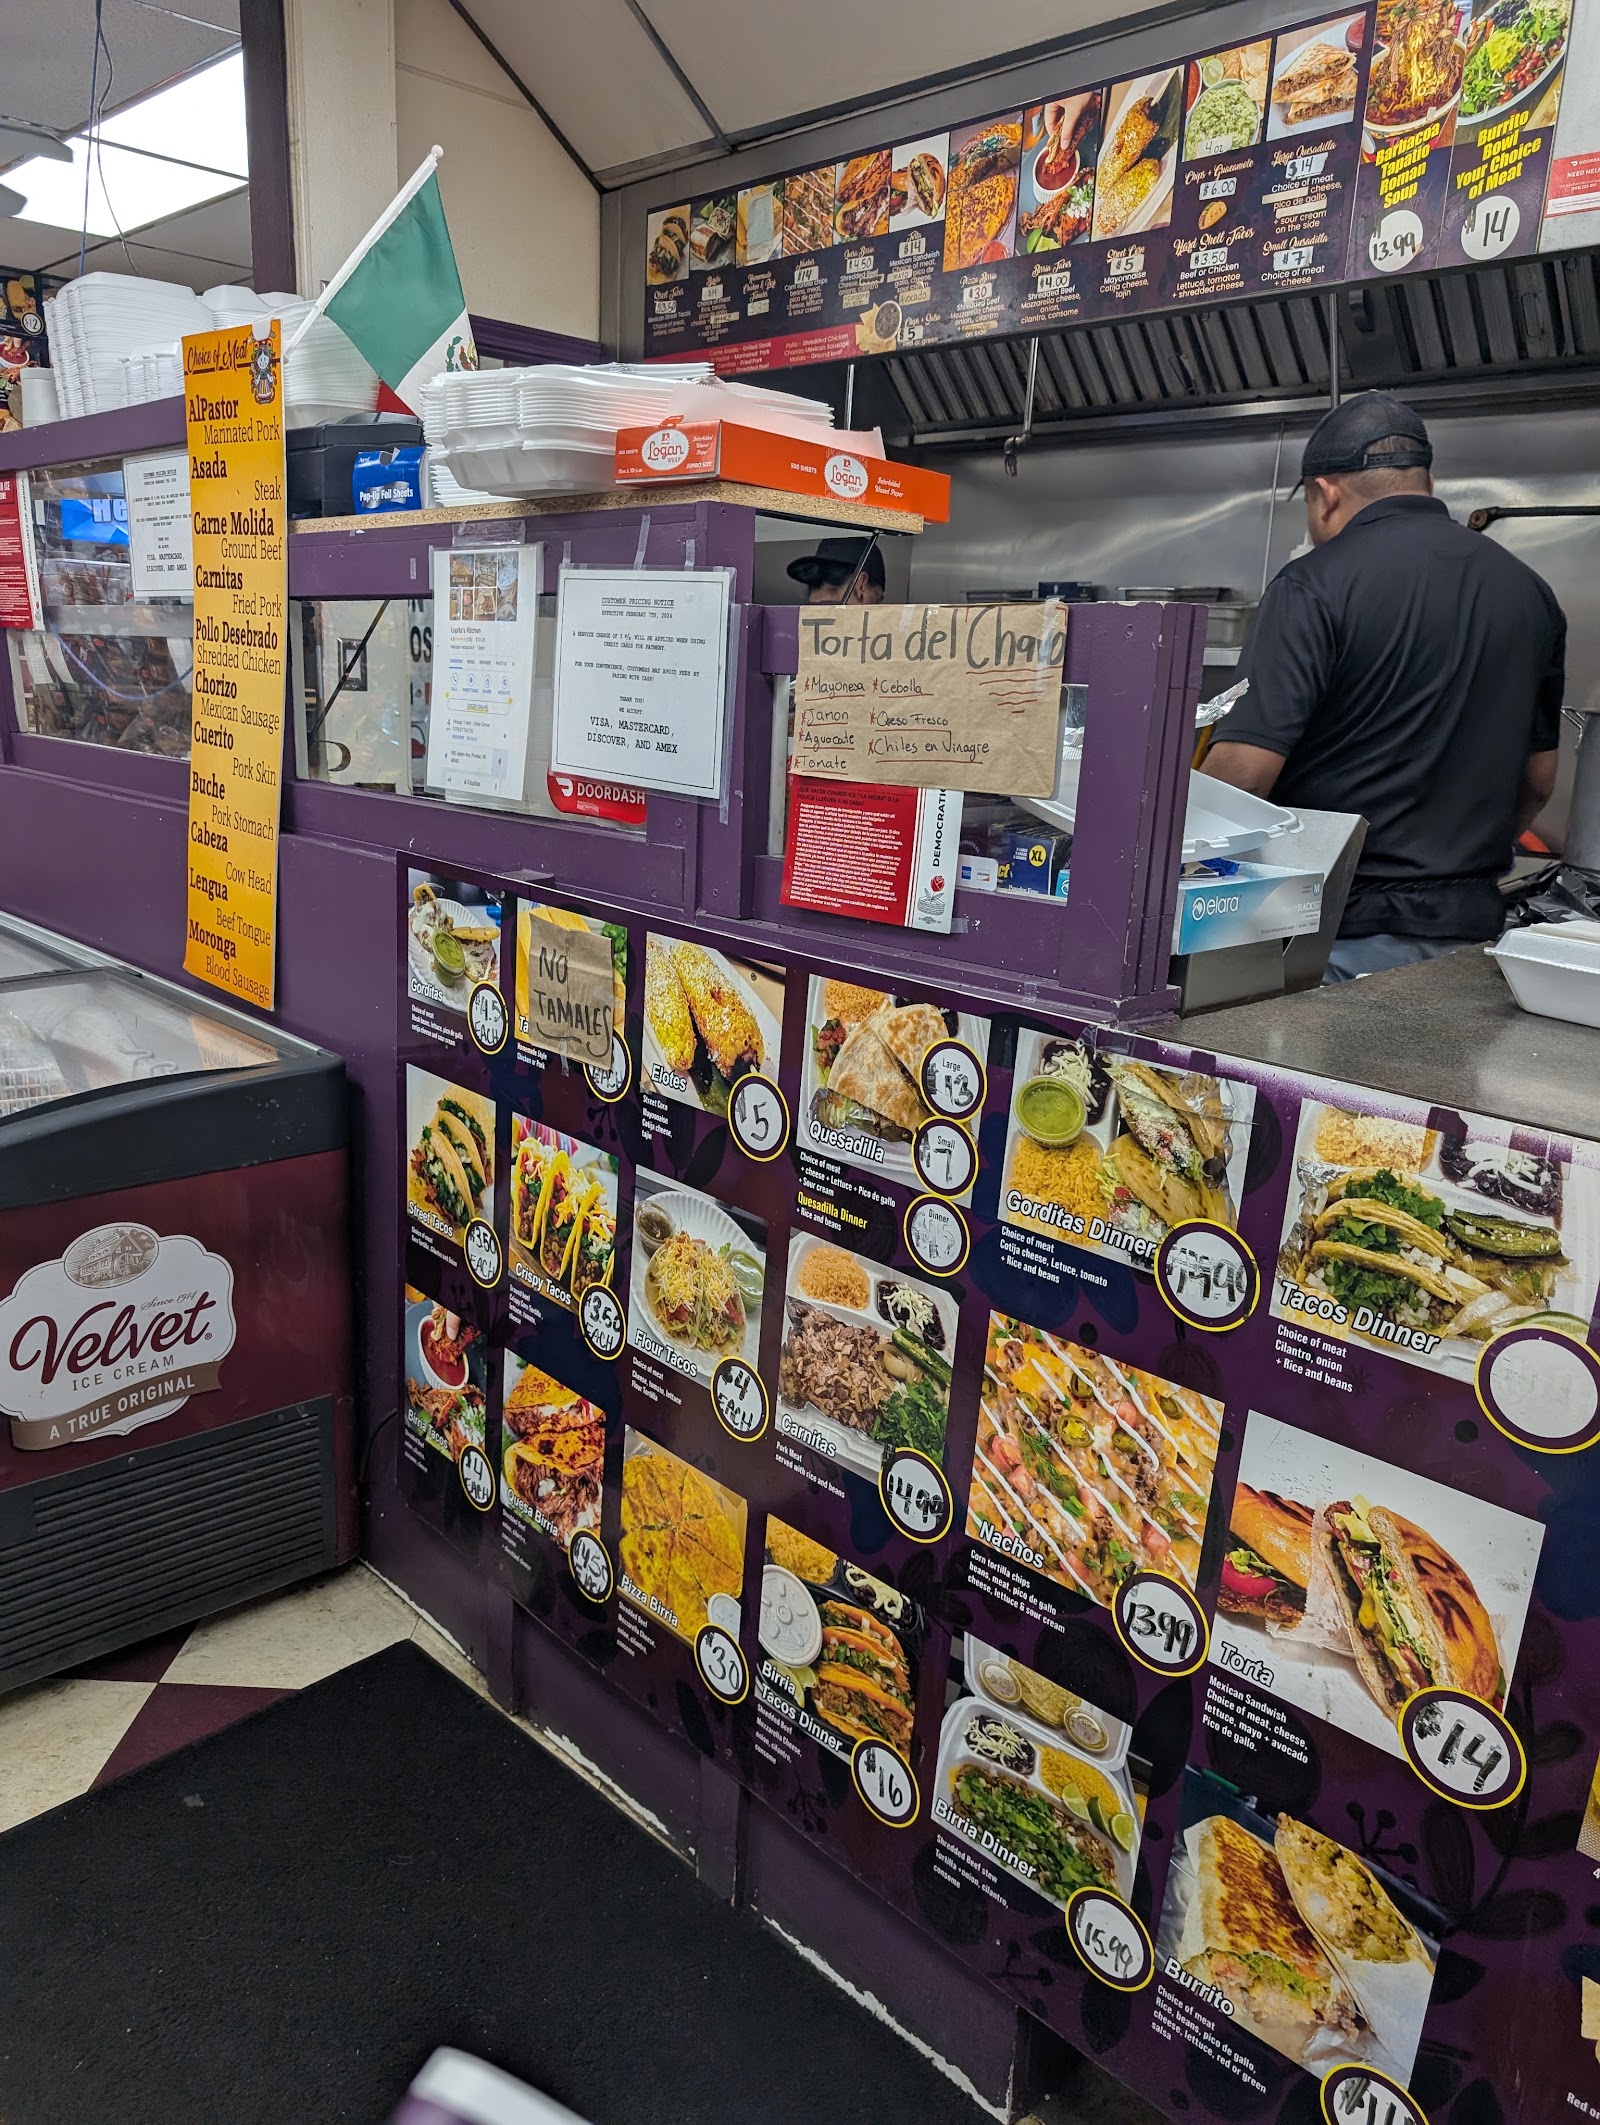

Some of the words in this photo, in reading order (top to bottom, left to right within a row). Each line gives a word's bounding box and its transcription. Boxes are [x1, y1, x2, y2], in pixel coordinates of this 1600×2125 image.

[1375, 122, 1440, 166] Barbacoa
[1478, 110, 1529, 147] Burrito
[1483, 129, 1519, 161] Bowl
[1381, 144, 1430, 179] Tapatio
[1456, 162, 1489, 190] Your
[1490, 137, 1542, 174] Choice
[1271, 180, 1300, 193] Choice
[1311, 174, 1334, 186] meat
[1379, 162, 1426, 196] Roman
[1469, 185, 1484, 200] of
[1485, 162, 1523, 192] Meat
[1383, 182, 1418, 209] Soup
[1280, 215, 1299, 225] sour
[1300, 210, 1327, 222] cream
[1173, 237, 1198, 257] Hard
[1199, 230, 1225, 251] Shell
[1225, 226, 1255, 246] Tacos
[1180, 270, 1197, 280] Beef
[1207, 262, 1239, 275] Chicken
[1207, 273, 1241, 285] tomatoe
[1178, 285, 1214, 299] shredded
[1215, 280, 1244, 292] cheese
[187, 346, 212, 374] Choice
[188, 397, 239, 423] AlPastor
[204, 424, 254, 445] Marinated
[256, 416, 281, 442] Pork
[191, 451, 228, 480] Asada
[647, 441, 685, 461] Logan
[800, 465, 818, 474] SHEETS
[830, 464, 864, 488] Logan
[254, 476, 282, 502] Steak
[359, 490, 380, 504] Pop-Up
[393, 487, 414, 499] Sheets
[194, 511, 227, 536] Carne
[230, 508, 275, 537] Molida
[221, 537, 257, 560] Ground
[259, 537, 283, 561] Beef
[195, 564, 243, 591] Carnitas
[232, 593, 256, 615] Fried
[259, 595, 283, 618] Pork
[196, 618, 219, 643] Pollo
[222, 620, 278, 650] Desebrado
[802, 611, 892, 664] Torta
[904, 607, 957, 662] del
[197, 644, 239, 671] Shredded
[241, 648, 282, 675] Chicken
[195, 669, 238, 700] Chorizo
[880, 677, 923, 695] Cebolla
[200, 697, 239, 723] Mexican
[241, 704, 280, 735] Sausage
[590, 716, 613, 730] VISA,
[618, 720, 675, 738] MASTERCARD,
[910, 713, 949, 727] Fresco
[193, 721, 234, 751] Cuerito
[587, 732, 630, 749] DISCOVER,
[635, 739, 651, 750] AND
[655, 741, 678, 754] AMEX
[874, 736, 918, 754] Chiles
[191, 771, 225, 801] Buche
[232, 756, 253, 779] Pork
[255, 760, 277, 787] Skin
[577, 782, 646, 805] DOORDASH
[190, 821, 229, 854] Cabeza
[212, 804, 232, 828] Pork
[233, 809, 275, 842] Stomach
[1031, 848, 1044, 862] XL
[189, 867, 229, 902] Lengua
[225, 860, 246, 885] Cow
[248, 867, 273, 896] Head
[1207, 896, 1240, 916] elara
[188, 918, 237, 960] Moronga
[216, 907, 236, 931] Beef
[236, 914, 272, 947] Tongue
[205, 954, 230, 985] Blood
[232, 963, 271, 1003] Sausage
[539, 946, 569, 985] NO
[411, 977, 444, 1002] Gorditas
[533, 988, 612, 1058] TAMALES
[651, 1063, 688, 1092] Elotes
[942, 1057, 962, 1072] Large
[809, 1120, 886, 1164] Quesadilla
[800, 1151, 819, 1168] Choice
[825, 1161, 841, 1175] meat
[409, 1200, 430, 1227] Street
[431, 1215, 453, 1238] Tacos
[797, 1190, 839, 1218] Quesadilla
[840, 1203, 868, 1230] Dinner
[928, 1208, 950, 1225] Dinner
[1006, 1190, 1085, 1235] Gorditas
[1088, 1217, 1158, 1259] Dinner
[999, 1238, 1021, 1257] Cotija
[1021, 1246, 1050, 1268] cheese,
[1050, 1257, 1079, 1278] Letuce,
[1080, 1268, 1108, 1288] tomato
[1006, 1254, 1022, 1270] Rice
[1037, 1266, 1061, 1285] beans
[515, 1262, 544, 1291] Crispy
[545, 1280, 572, 1306] Tacos
[140, 1295, 175, 1312] Since
[176, 1290, 198, 1303] 1914
[1279, 1280, 1349, 1325] Tacos
[1351, 1305, 1441, 1355] Dinner
[9, 1291, 216, 1385] Velvet
[635, 1328, 664, 1358] Flour
[666, 1345, 698, 1378] Tacos
[1277, 1324, 1308, 1345] Choice
[1322, 1341, 1348, 1359] meat
[1274, 1339, 1314, 1364] Cilantro,
[1315, 1354, 1343, 1373] onion
[72, 1372, 104, 1392] ICE
[113, 1354, 175, 1380] CREAM
[49, 1424, 61, 1440] A
[67, 1403, 111, 1434] TRUE
[117, 1374, 196, 1412] ORIGINAL
[407, 1408, 427, 1433] Birria
[428, 1425, 450, 1450] Tacos
[781, 1414, 837, 1458] Carnitas
[507, 1488, 533, 1517] Quesa
[534, 1509, 559, 1537] Birria
[979, 1520, 1045, 1570] Nachos
[970, 1549, 987, 1565] Corn
[987, 1555, 1011, 1578] tortilla
[1011, 1570, 1031, 1589] chips
[621, 1574, 648, 1606] Pizza
[650, 1596, 678, 1629] Birria
[994, 1586, 1019, 1608] lettuce
[762, 1660, 797, 1697] Birria
[1220, 1641, 1275, 1688] Torta
[1208, 1674, 1244, 1701] Mexican
[1245, 1691, 1287, 1724] Sandwish
[761, 1683, 796, 1721] Tacos
[798, 1712, 844, 1753] Dinner
[1204, 1701, 1237, 1729] lettuce,
[1238, 1720, 1262, 1742] mayo
[1271, 1737, 1310, 1765] avocado
[934, 1798, 978, 1841] Birria
[980, 1832, 1038, 1880] Dinner
[1163, 1955, 1235, 2017] Burrito
[1151, 2021, 1172, 2041] salsa
[1203, 2029, 1221, 2049] pico
[1566, 2091, 1588, 2112] Red
